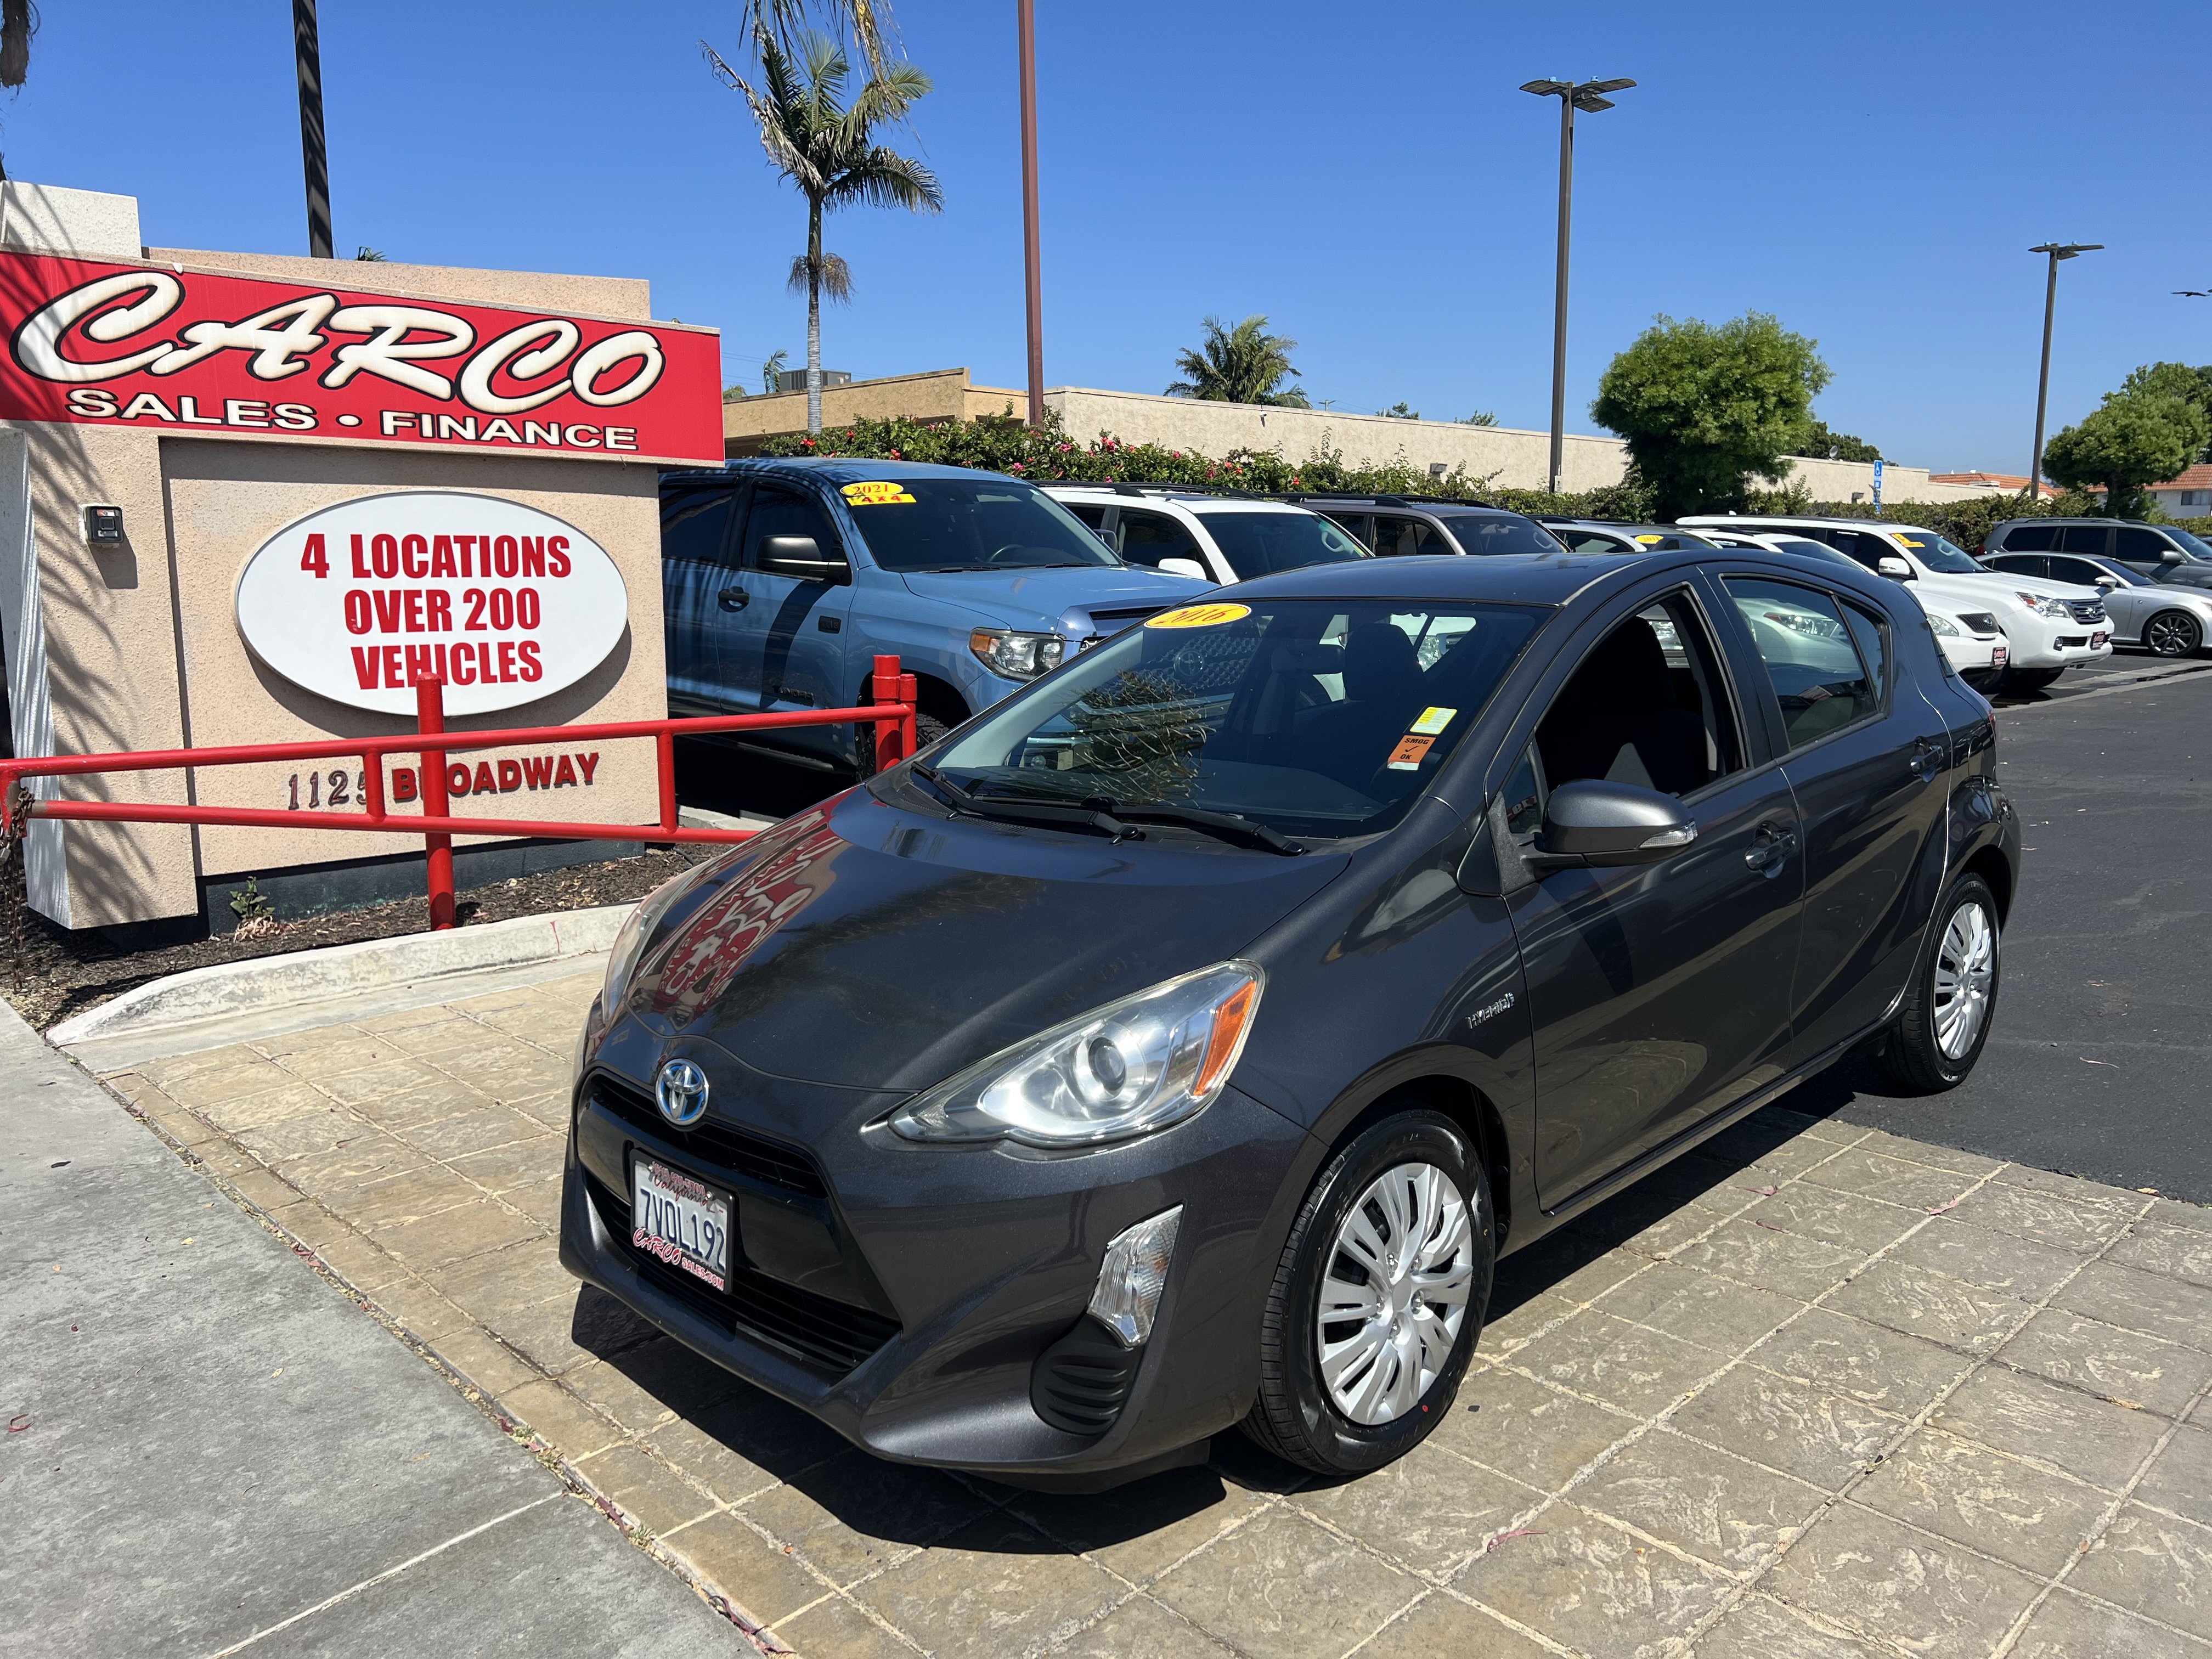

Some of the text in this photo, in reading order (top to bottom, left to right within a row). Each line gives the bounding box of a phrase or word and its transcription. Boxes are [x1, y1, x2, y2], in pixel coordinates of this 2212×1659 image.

[13, 271, 664, 414] CARCO
[65, 388, 640, 451] SALES FINANCE
[853, 484, 888, 496] 2021
[300, 533, 571, 579] 4 LOCATIONS
[344, 588, 541, 635] OVER 200
[1154, 607, 1240, 624] 2016
[351, 640, 543, 690] VEHICLES
[392, 753, 599, 799] BOADWAY
[633, 1227, 681, 1265] CARCO
